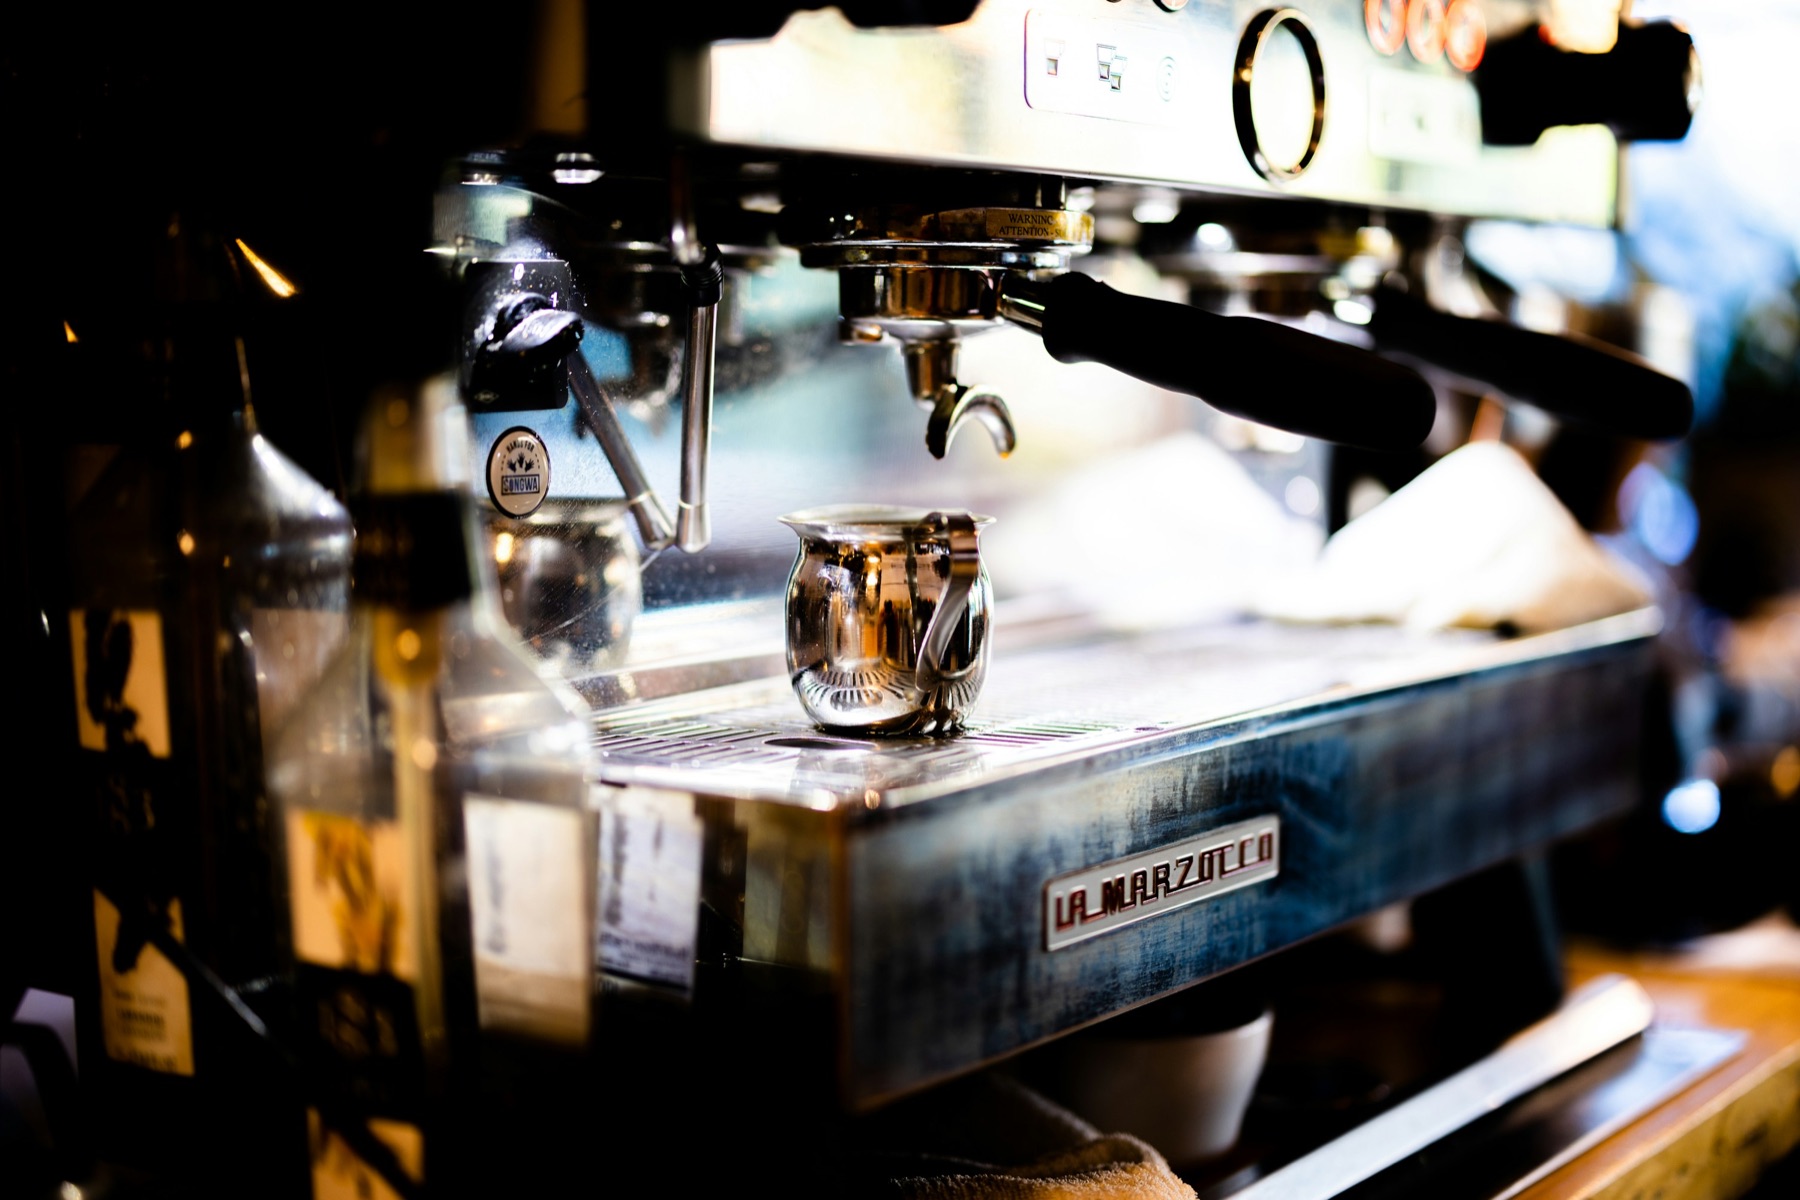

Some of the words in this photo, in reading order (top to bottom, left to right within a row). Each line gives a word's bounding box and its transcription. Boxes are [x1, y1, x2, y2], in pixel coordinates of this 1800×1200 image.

[999, 226, 1049, 236] ATTENTION
[524, 440, 535, 453] FOR
[503, 477, 538, 492] SONGWA
[1055, 884, 1088, 932] LA
